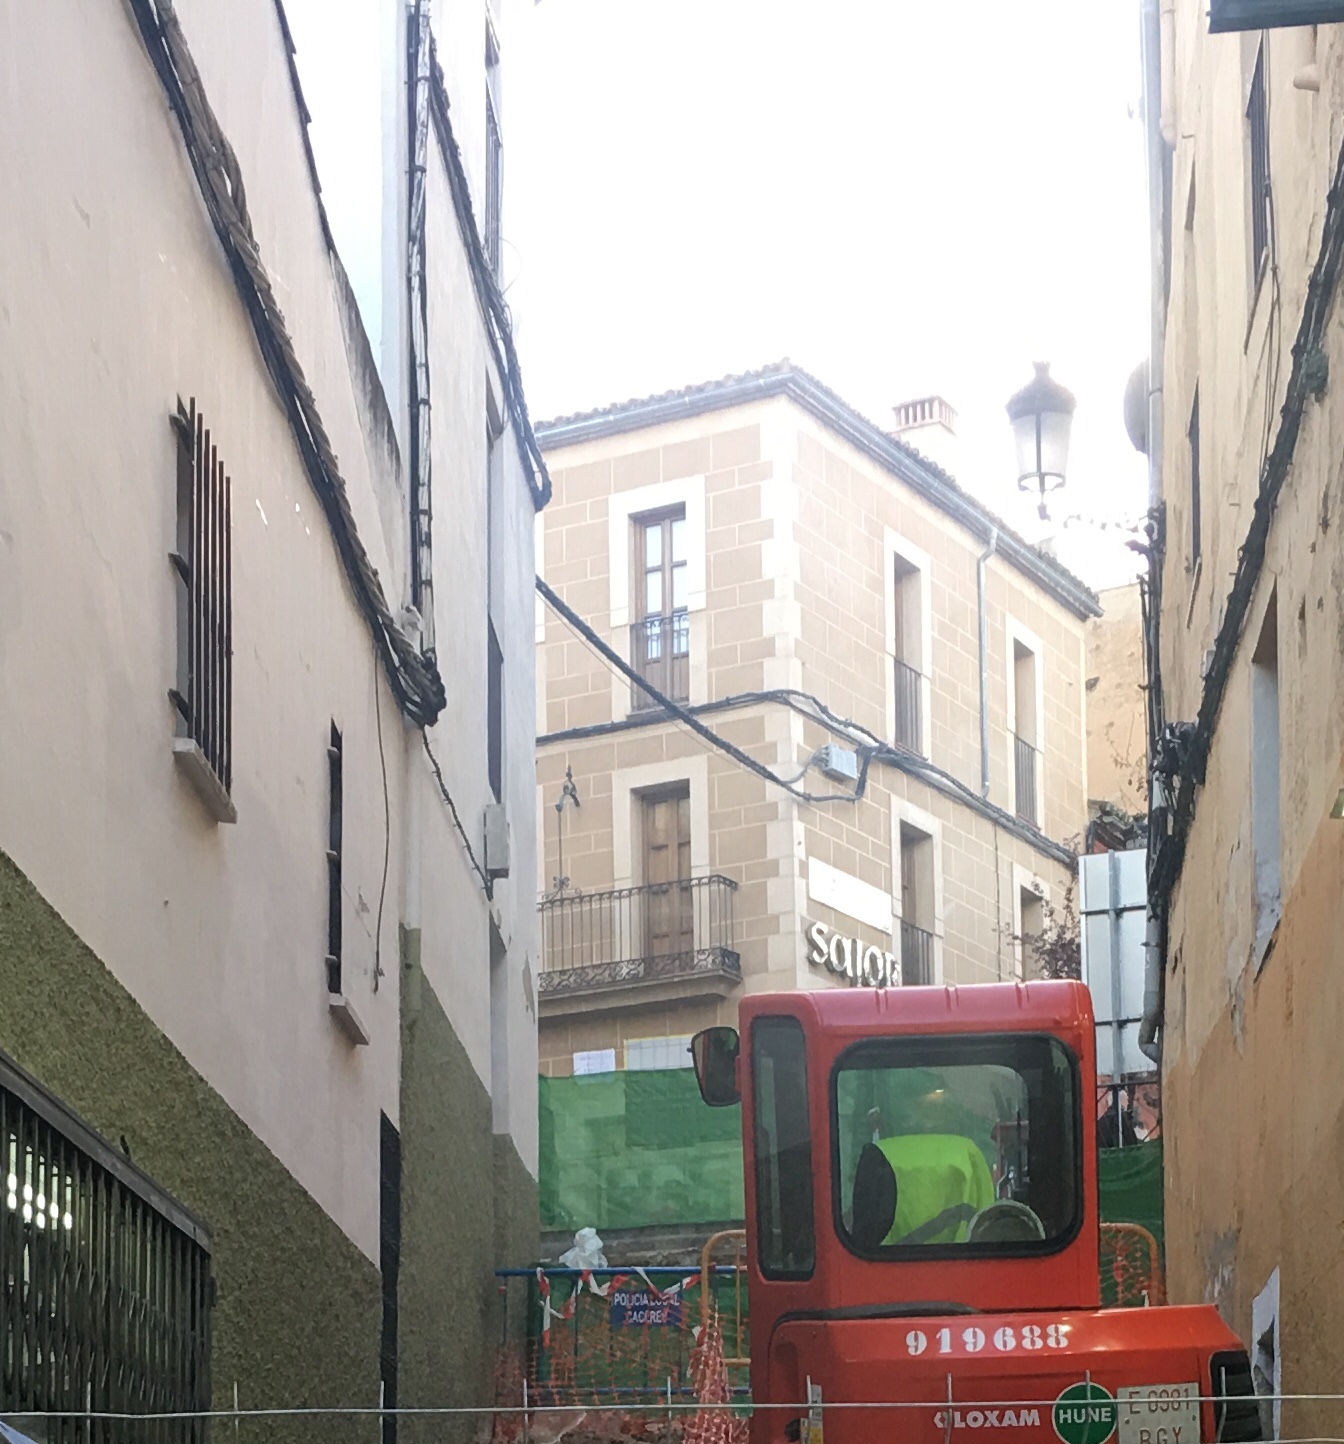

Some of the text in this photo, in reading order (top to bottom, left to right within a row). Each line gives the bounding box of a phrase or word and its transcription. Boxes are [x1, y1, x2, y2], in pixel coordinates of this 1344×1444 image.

[906, 1323, 1069, 1356] 919688
[954, 1408, 1041, 1428] LOXAM
[1058, 1407, 1112, 1425] HUNE
